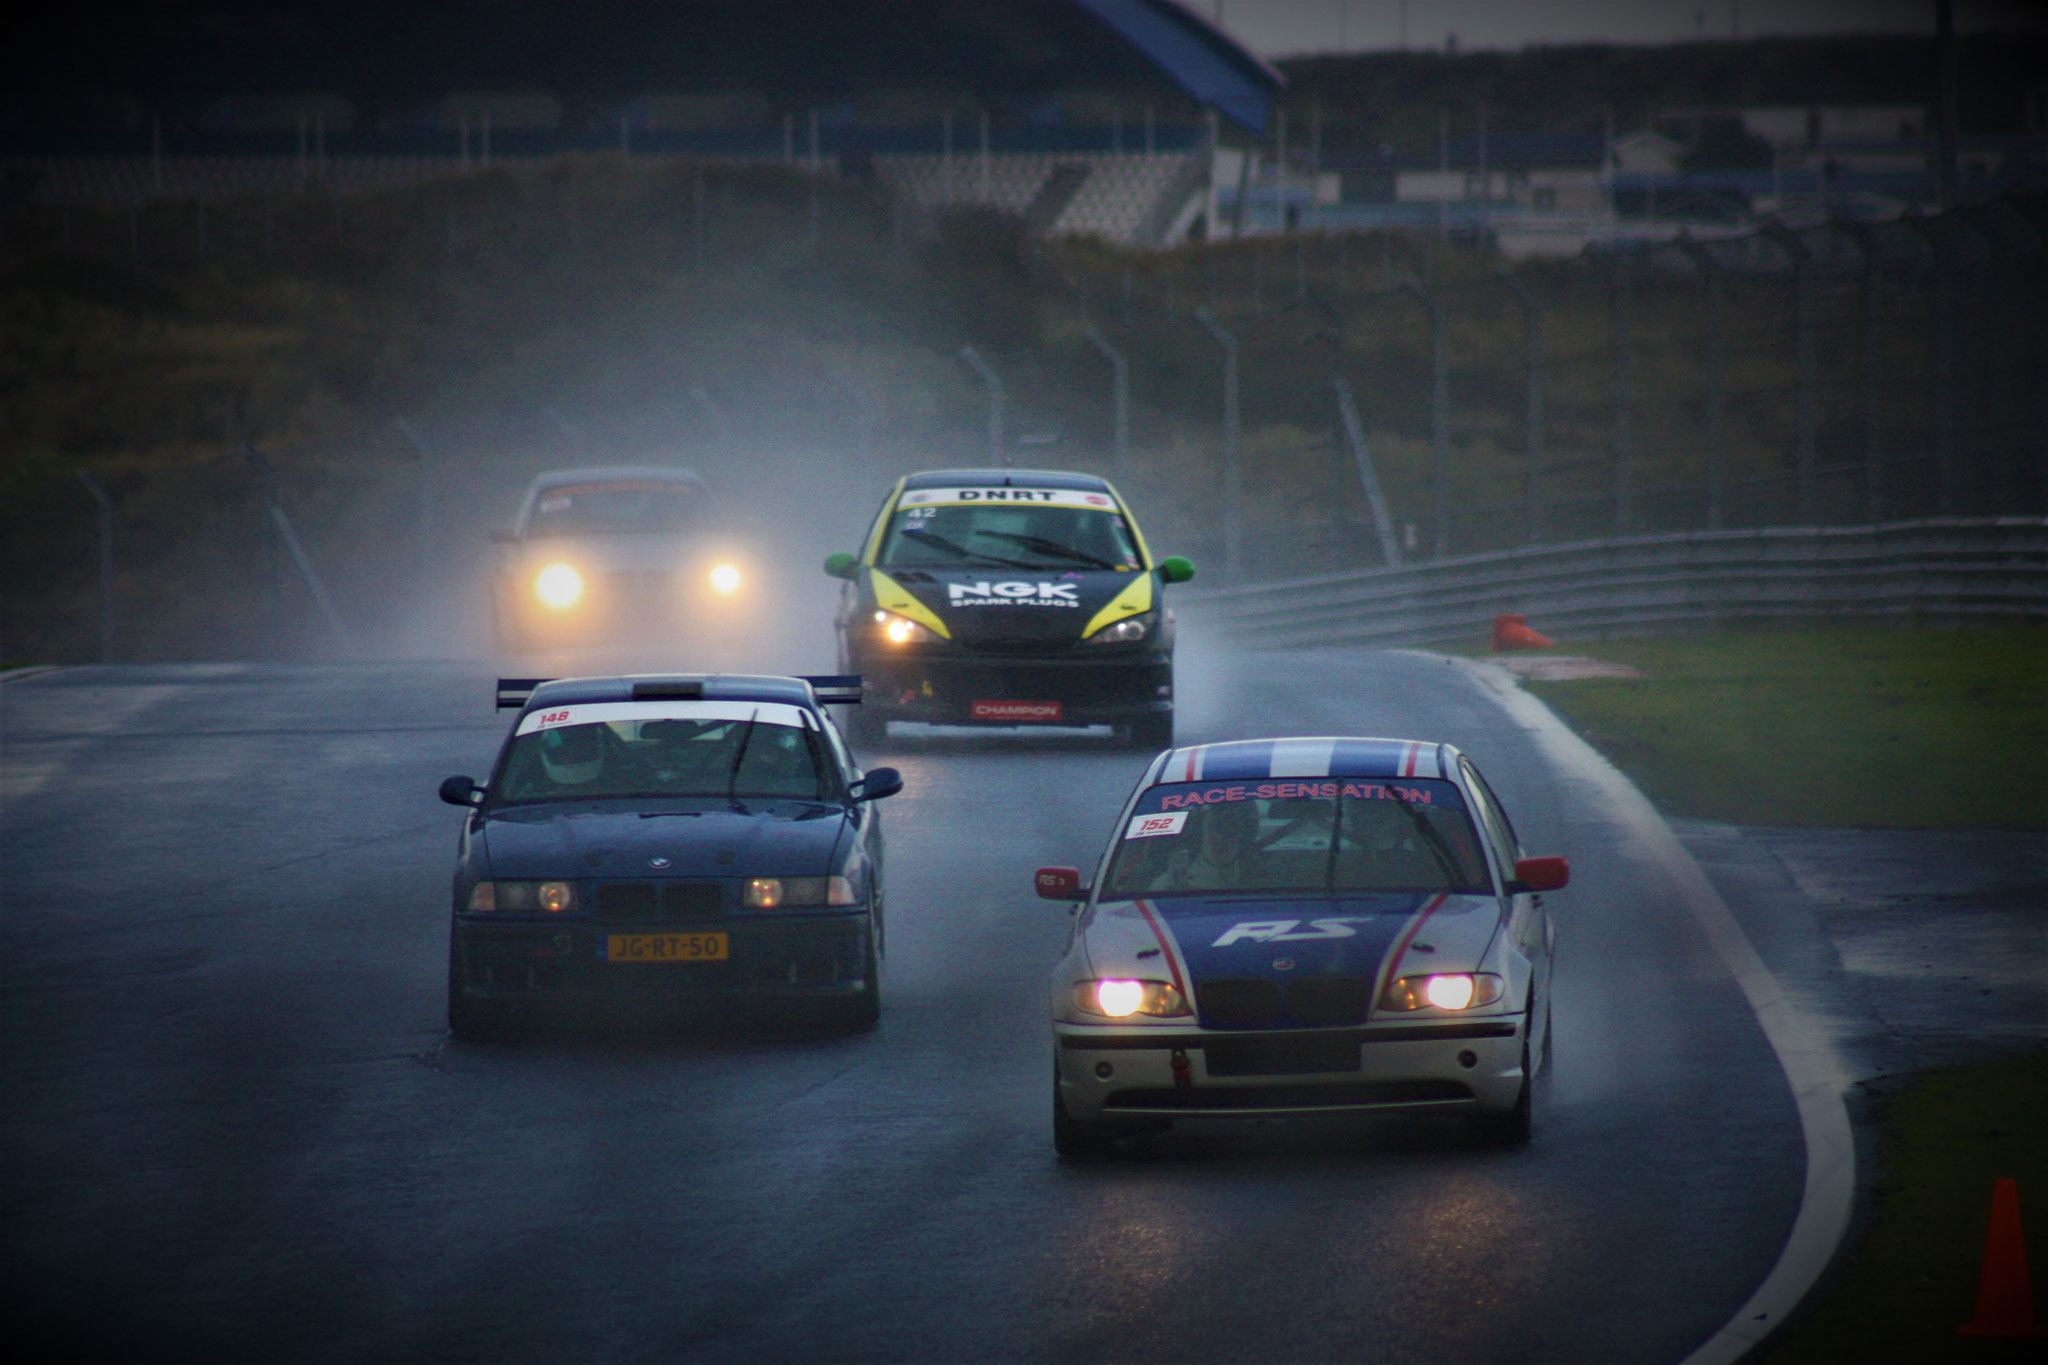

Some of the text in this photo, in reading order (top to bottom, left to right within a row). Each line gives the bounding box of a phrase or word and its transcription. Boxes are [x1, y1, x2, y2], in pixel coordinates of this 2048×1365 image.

[959, 491, 1056, 501] DNRT
[908, 507, 936, 518] 42
[949, 581, 1079, 600] NGK
[951, 598, 1079, 608] SPARK PLUGS
[976, 705, 1057, 716] CHAMPION
[541, 711, 569, 724] 148
[1162, 783, 1431, 810] RACE-SENSATION
[1141, 818, 1174, 831] 152
[616, 936, 719, 957] JG-RT-50
